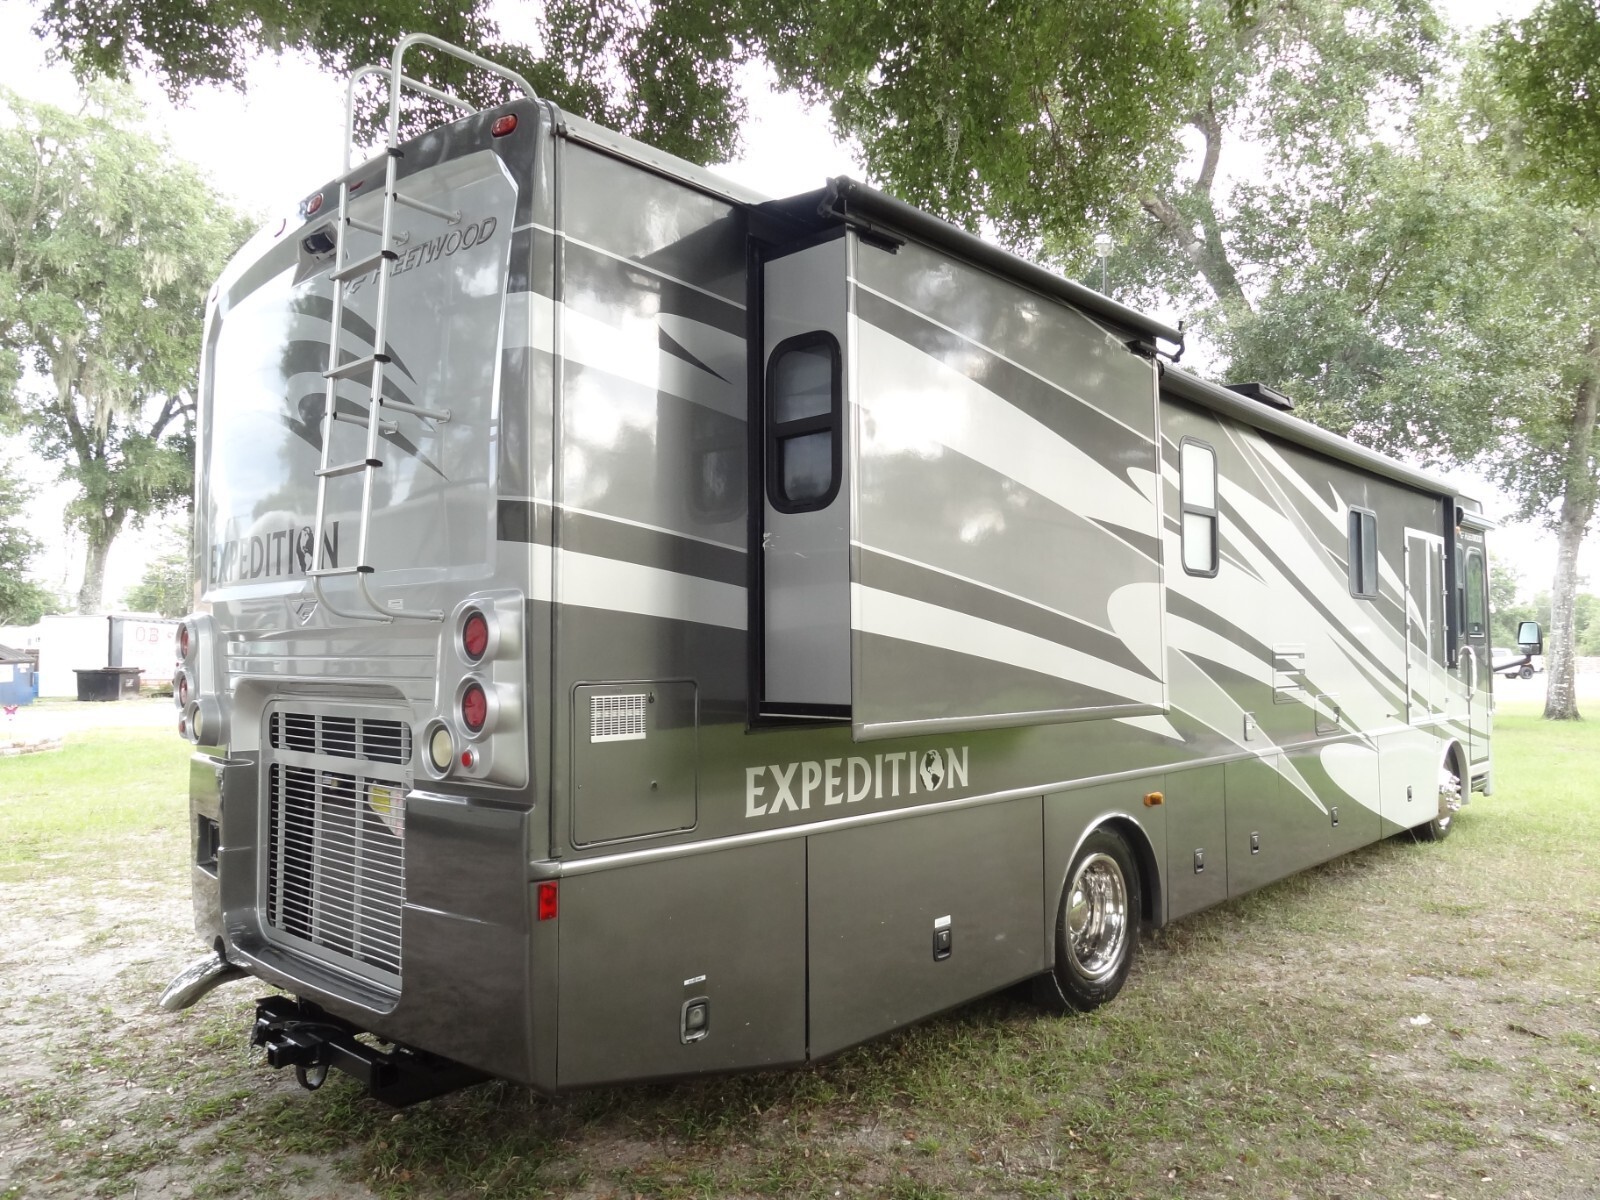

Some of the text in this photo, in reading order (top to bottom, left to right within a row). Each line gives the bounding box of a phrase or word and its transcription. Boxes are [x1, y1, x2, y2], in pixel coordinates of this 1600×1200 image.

[371, 216, 498, 285] EETWOOD
[210, 520, 340, 585] EXPEDITION
[745, 746, 970, 818] EXPEDITION
